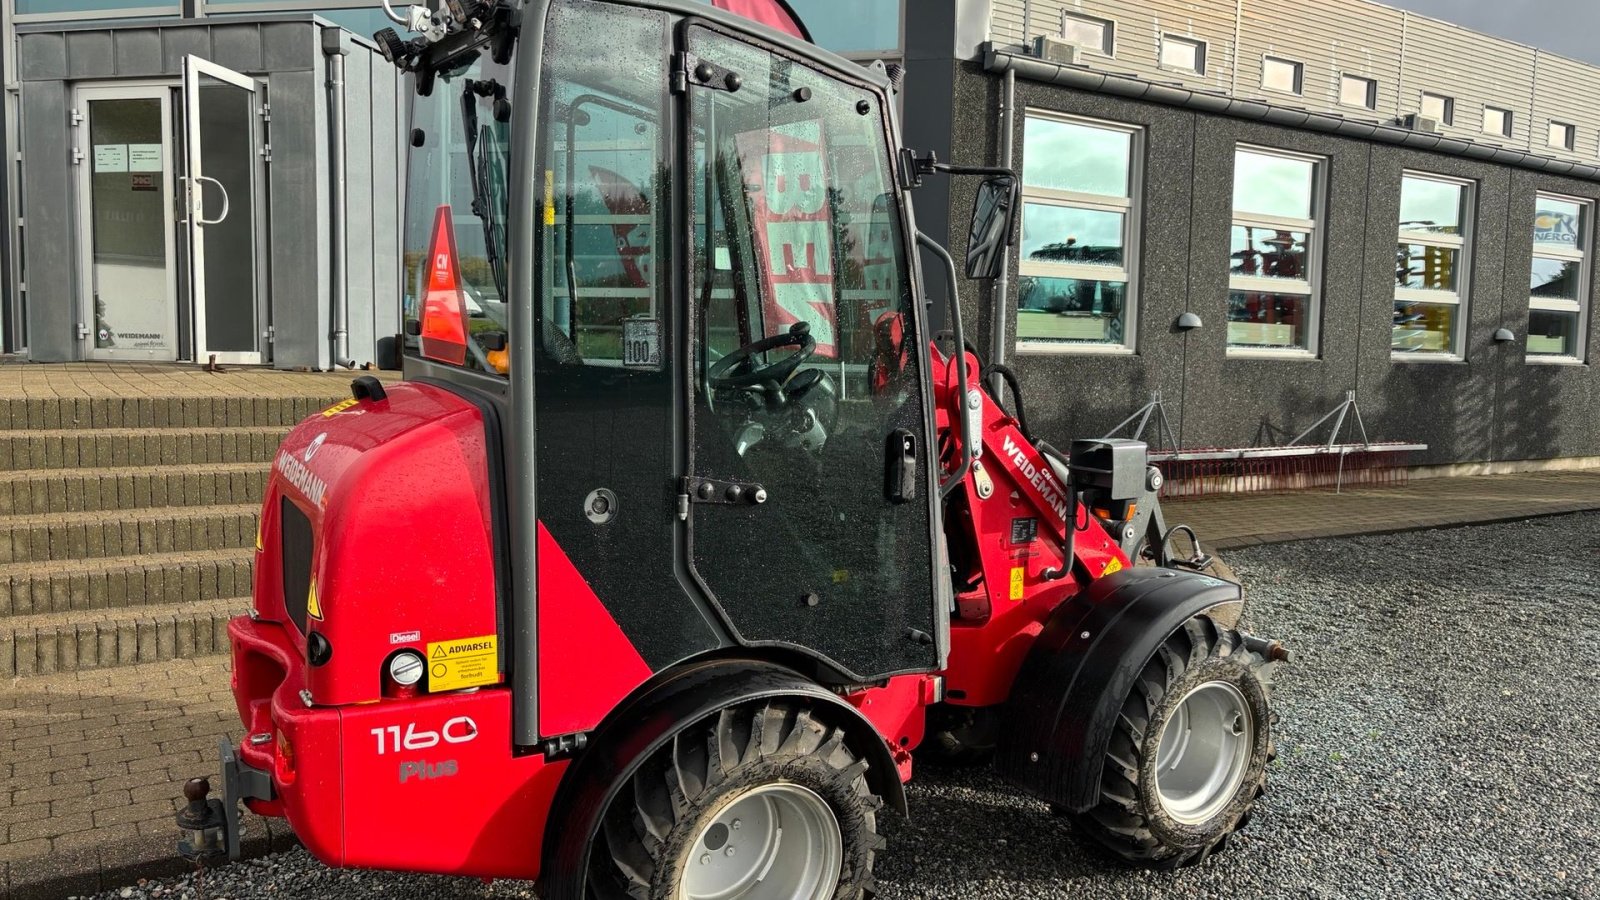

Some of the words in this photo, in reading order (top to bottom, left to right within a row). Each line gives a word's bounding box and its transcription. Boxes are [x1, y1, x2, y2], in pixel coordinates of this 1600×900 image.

[437, 253, 448, 270] CN
[117, 332, 161, 340] WEIDEMANN
[278, 449, 328, 507] WEIDEMANN
[1041, 468, 1053, 481] CN
[392, 632, 419, 643] Diesel
[449, 642, 493, 654] ADVARSEL
[371, 716, 478, 755] 1160
[400, 760, 458, 783] Plus
